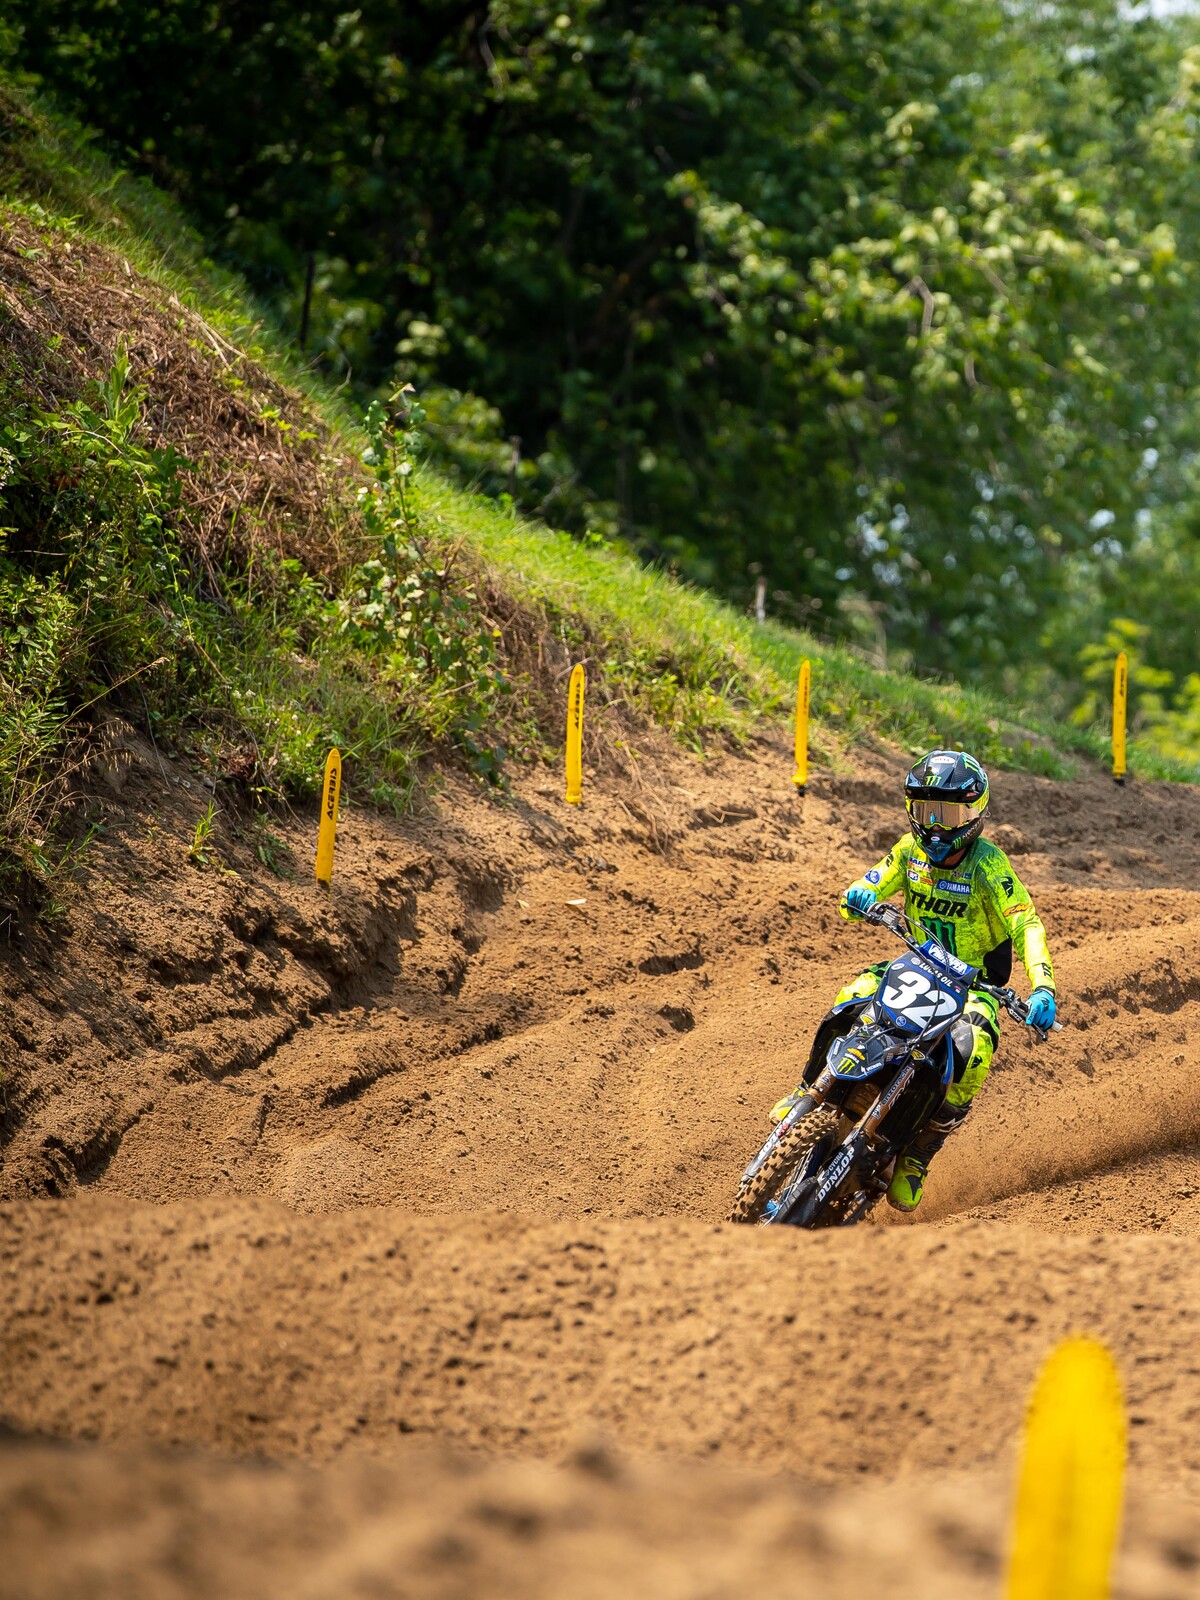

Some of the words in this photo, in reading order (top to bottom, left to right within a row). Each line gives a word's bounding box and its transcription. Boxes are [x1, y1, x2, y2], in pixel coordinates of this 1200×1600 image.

[327, 768, 337, 820] ACERBIS
[910, 889, 969, 918] THOR
[946, 882, 970, 893] YAMAHA
[882, 971, 958, 1029] 32
[940, 977, 953, 988] OIL
[818, 1147, 855, 1202] DUNLOP
